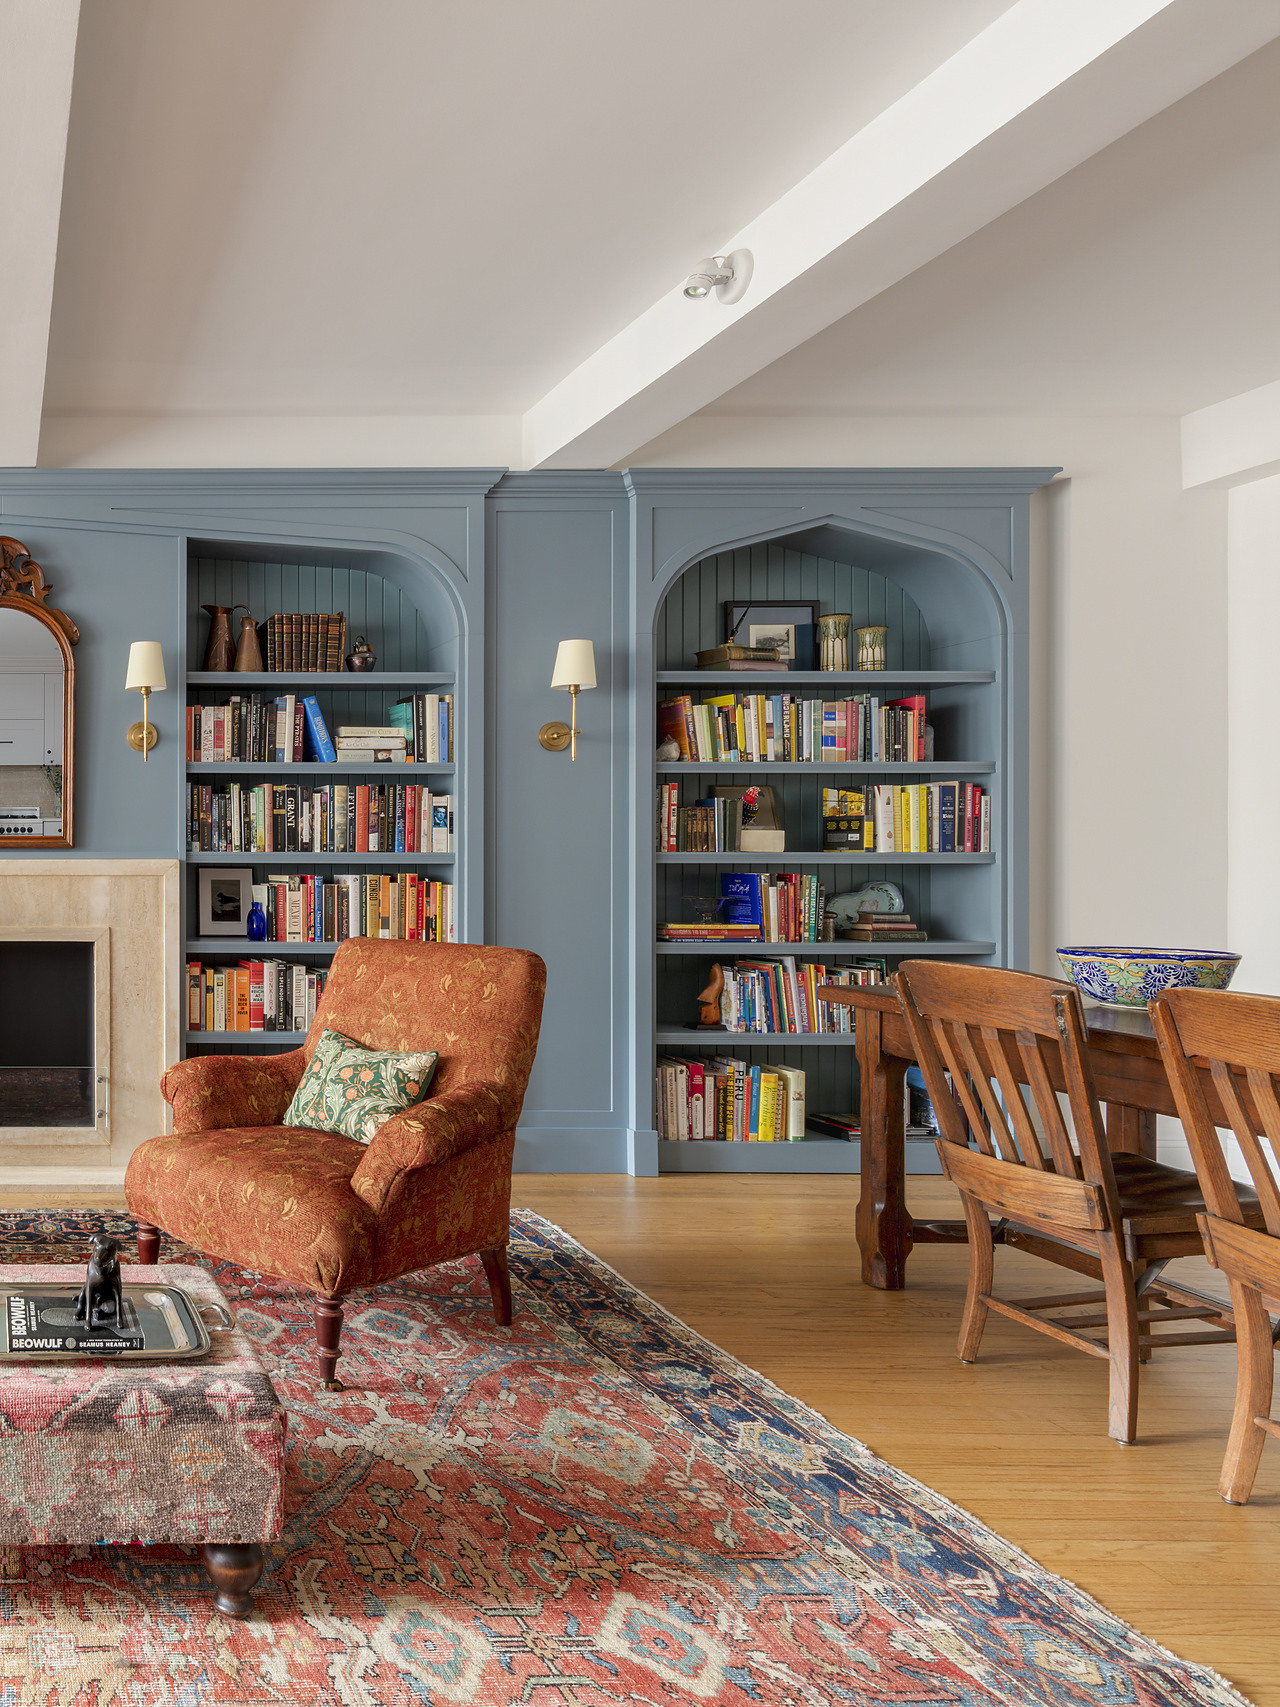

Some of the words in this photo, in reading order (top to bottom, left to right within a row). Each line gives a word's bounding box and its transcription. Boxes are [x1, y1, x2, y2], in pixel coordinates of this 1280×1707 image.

[369, 879, 378, 901] CONGO
[291, 900, 299, 927] MEXICO
[295, 974, 304, 1008] Churchill
[800, 993, 809, 1026] Andalucia
[735, 1070, 744, 1101] PERU
[760, 1086, 771, 1128] Everything
[10, 1297, 26, 1335] BEOWULF
[12, 1339, 62, 1348] BEOWULF
